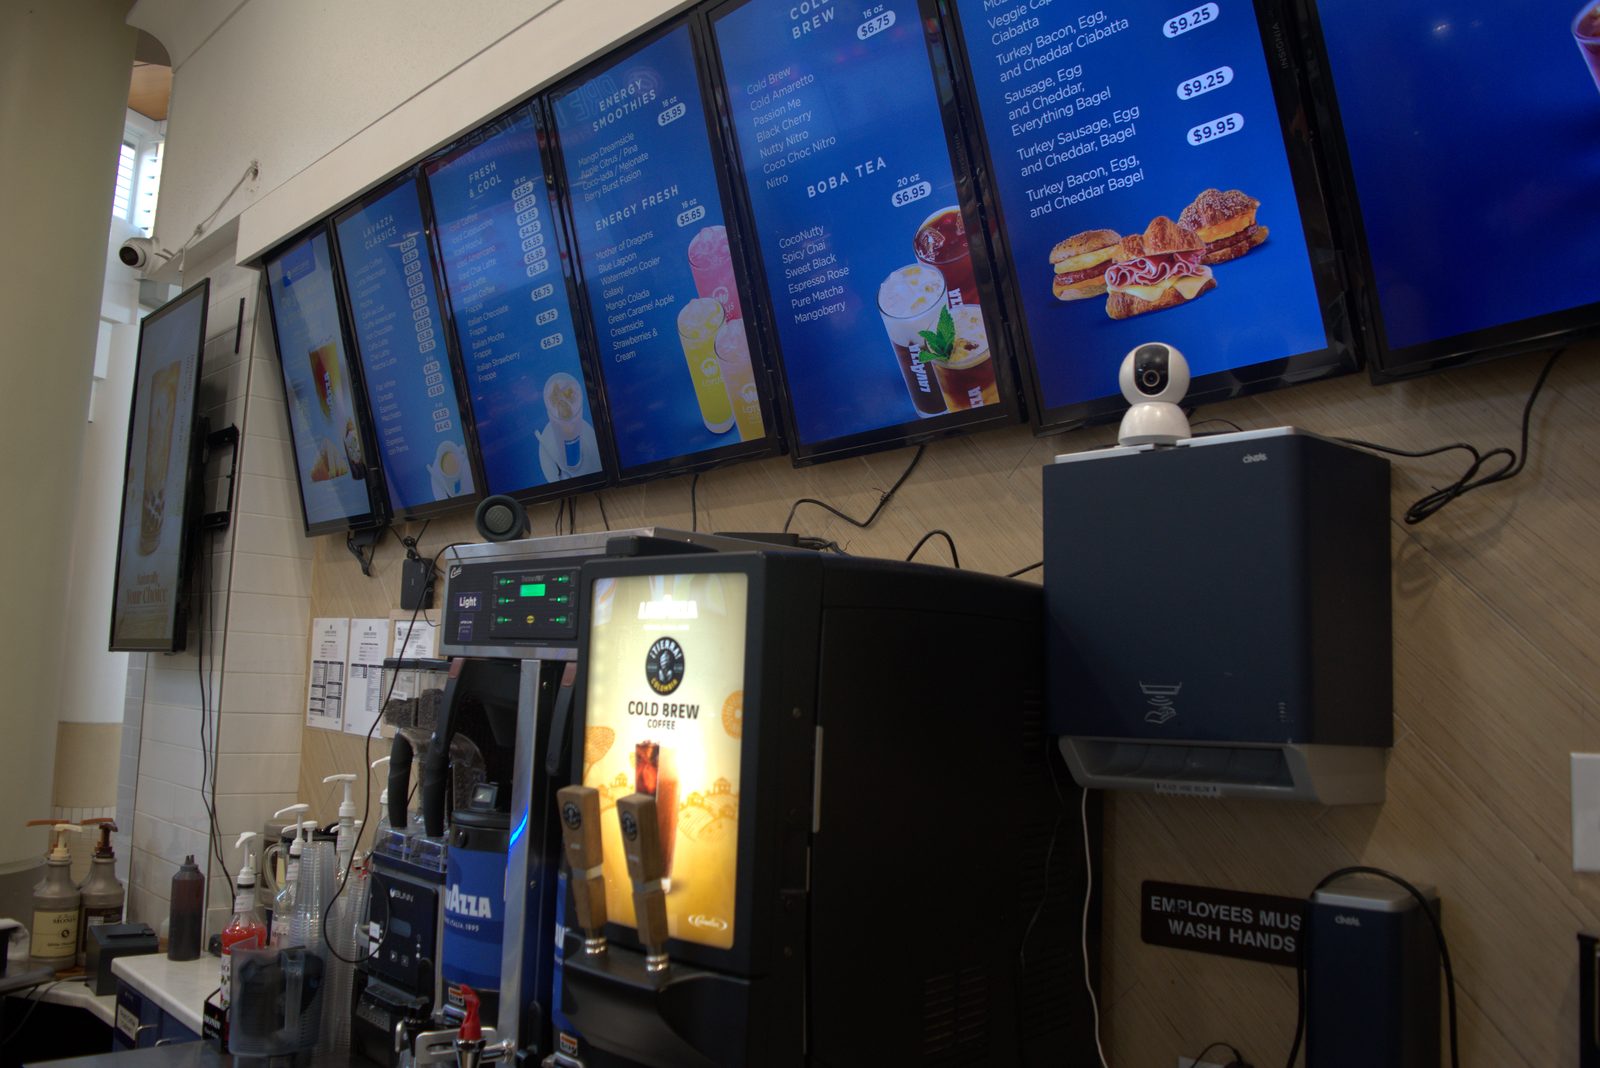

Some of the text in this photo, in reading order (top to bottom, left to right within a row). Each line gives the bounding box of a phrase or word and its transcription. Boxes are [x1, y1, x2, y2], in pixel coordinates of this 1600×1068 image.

[792, 7, 835, 39] BREW
[863, 4, 884, 19] 16 oz
[988, 5, 1027, 29] Veggie
[1169, 8, 1211, 35] $9.25
[861, 14, 890, 37] $6.75
[992, 17, 1039, 45] Ciabatta
[996, 11, 1107, 65] Turkey Bacon, Egg,
[1000, 19, 1129, 82] and Cheddar Ciabatta
[746, 67, 792, 95] Cold Brew
[750, 74, 814, 111] Cold Amaretto
[1004, 65, 1082, 104] Sausage, Egg
[1183, 71, 1225, 96] $9.25
[599, 79, 642, 112] ENERGY
[1008, 82, 1085, 120] and Cheddar,
[592, 89, 657, 132] SMOOTHIES
[660, 106, 683, 124] $5.95
[753, 98, 801, 128] Passion Me
[1011, 86, 1112, 136] Everything Bagel
[756, 110, 812, 143] Black Cherry
[1016, 106, 1140, 160] Turkey Sausage, Egg
[1193, 117, 1236, 142] $9.95
[760, 130, 809, 159] Nutty Nitro
[763, 136, 836, 174] Coco Choc Nitro
[1021, 123, 1136, 177] and Cheddar, Bagel
[468, 160, 497, 184] FRESH
[477, 174, 503, 194] COOL
[766, 174, 789, 190] Nitro
[807, 157, 887, 198] BOBA TEA
[896, 172, 921, 188] 20 oz
[1026, 155, 1140, 202] Turkey Bacon, Egg,
[895, 185, 926, 205] $6.95
[1030, 168, 1144, 218] and Cheddar Bagel
[595, 184, 679, 231] ENERGY FRESH
[779, 225, 824, 249] CocoNutty
[782, 239, 826, 264] Spicy Chai
[785, 253, 837, 279] Sweet Black
[603, 285, 624, 299] Galaxy
[788, 267, 850, 294] Espresso Rose
[627, 288, 650, 304] Colada
[792, 285, 844, 309] Pure Matcha
[794, 301, 846, 324] Mangoberry
[615, 350, 636, 363] Cream
[459, 596, 477, 609] Light
[628, 700, 700, 720] COLD BREW
[647, 718, 676, 730] COFFEE
[1150, 895, 1302, 932] EMPLOYEES MUS
[1168, 918, 1296, 953] WASH HANDS
